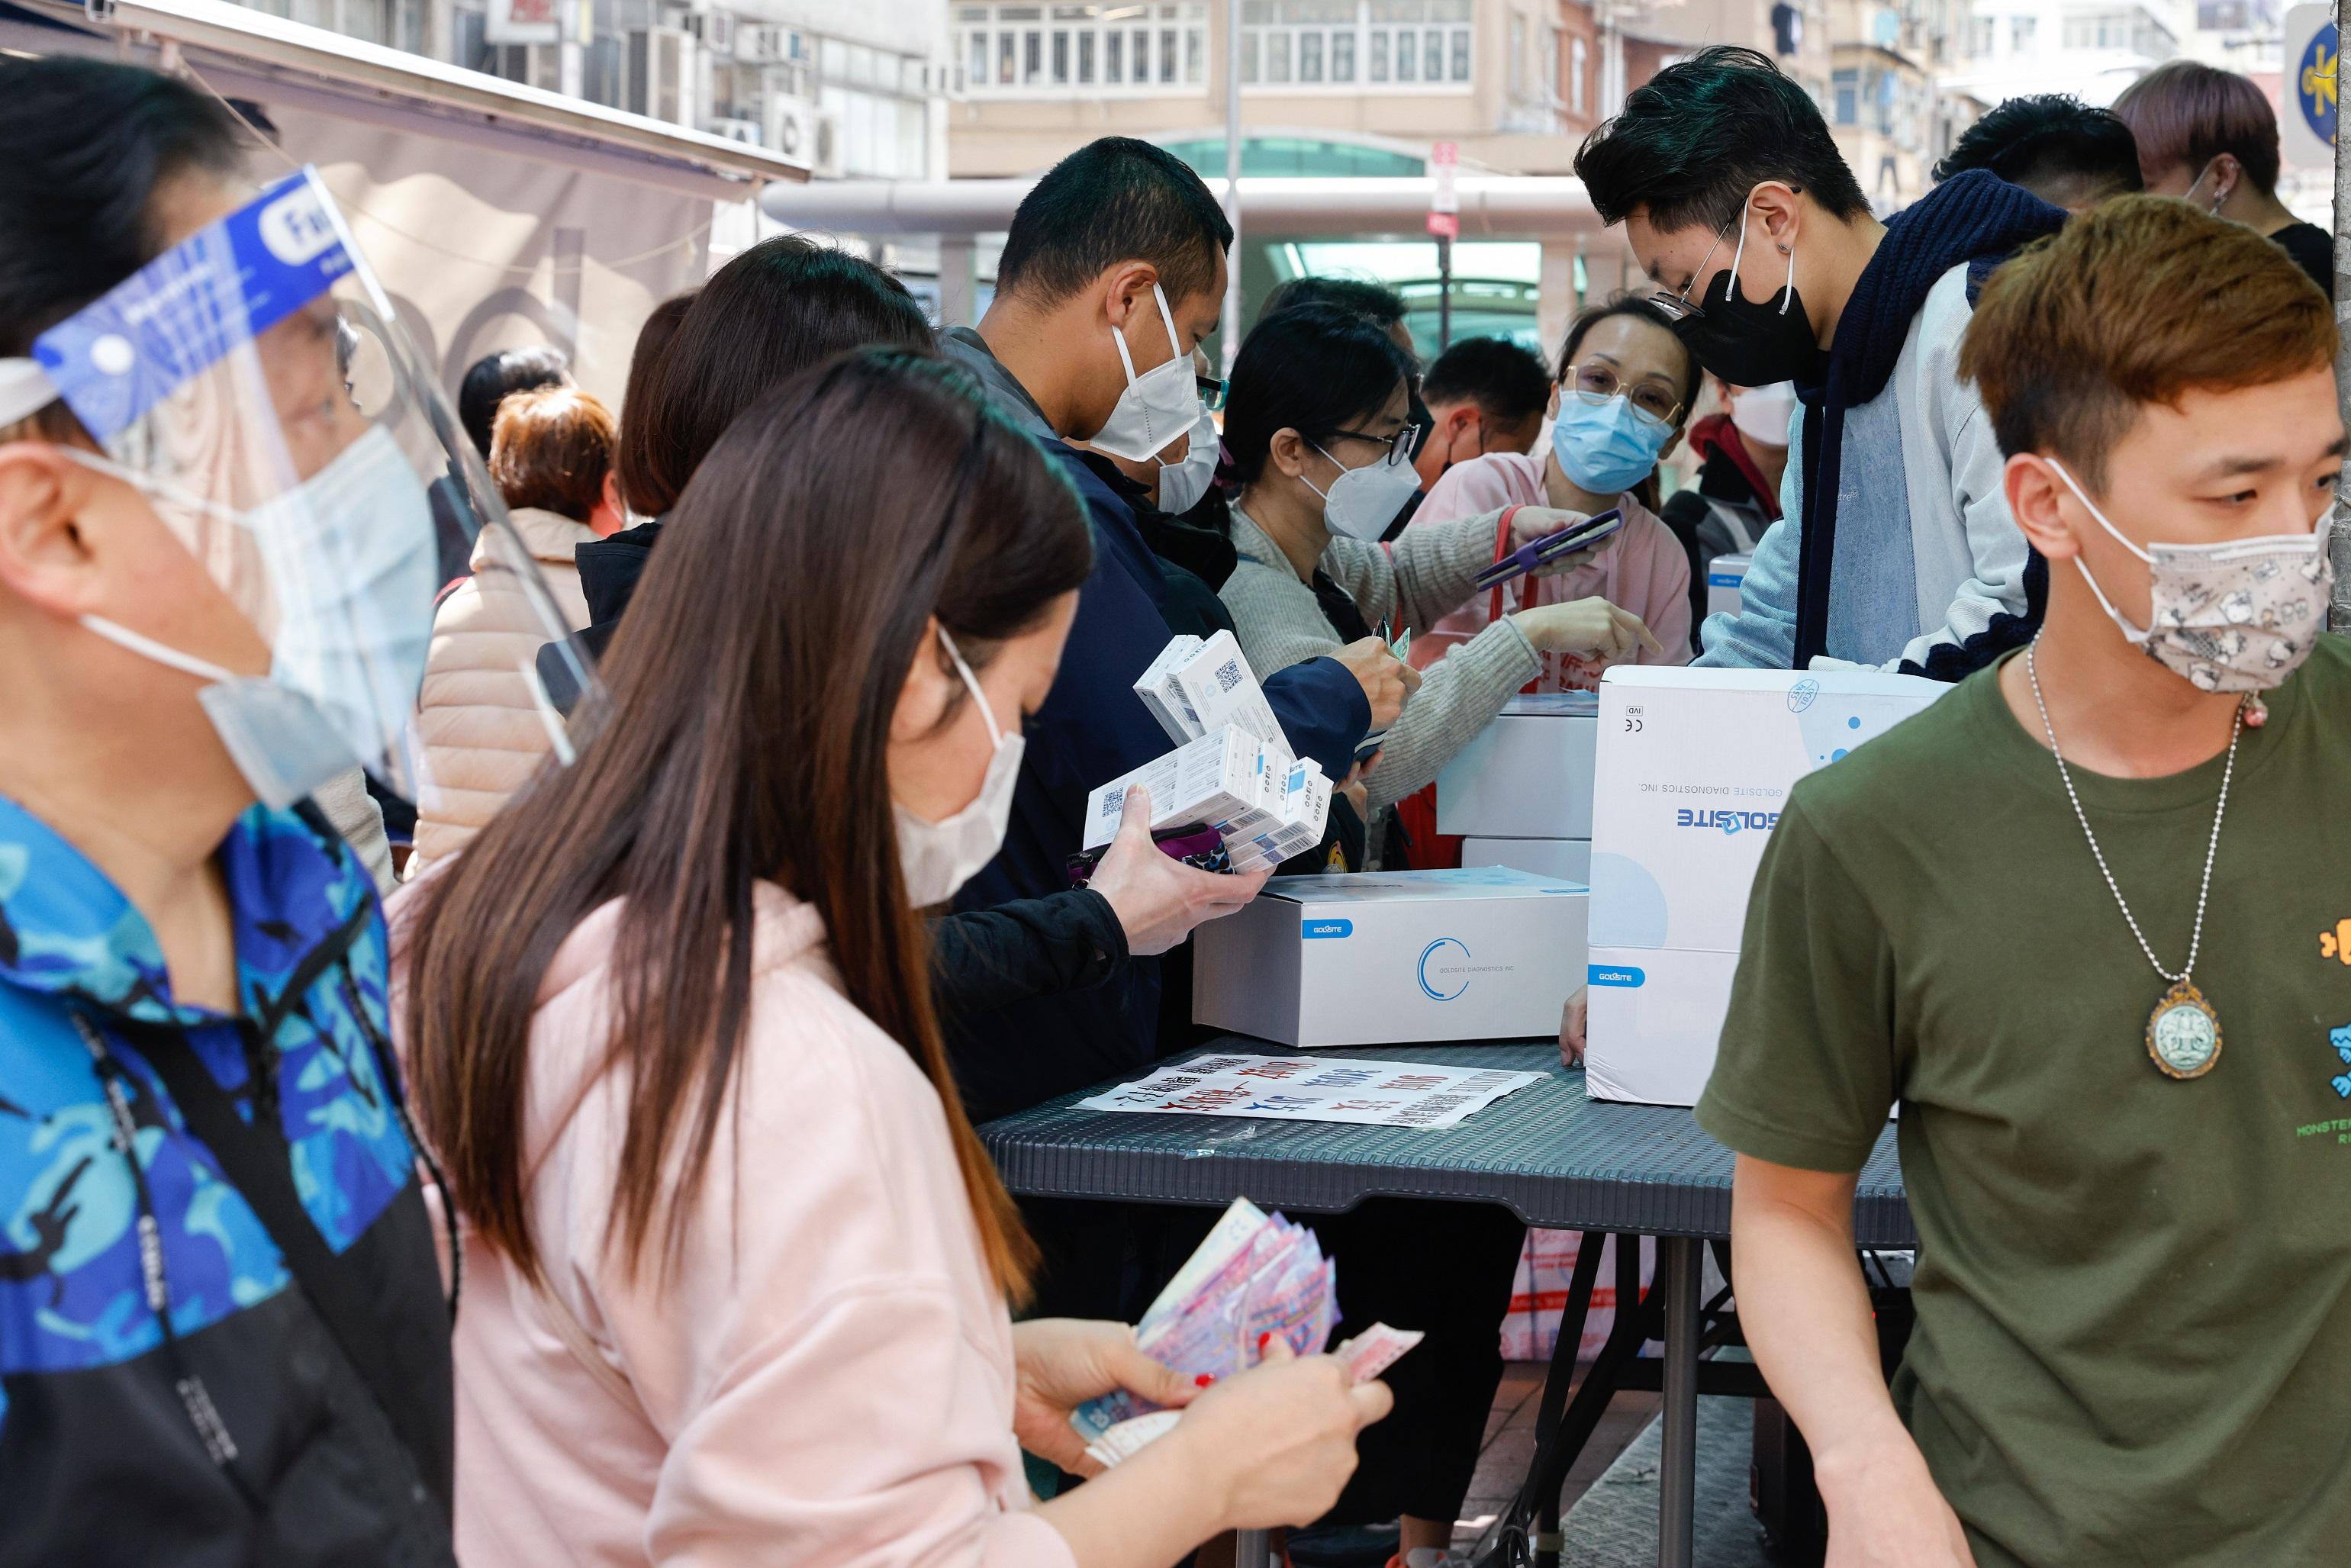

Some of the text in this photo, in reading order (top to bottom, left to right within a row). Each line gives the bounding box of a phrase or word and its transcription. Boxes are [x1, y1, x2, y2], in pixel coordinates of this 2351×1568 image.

[1791, 684, 1806, 700] PASS
[1625, 719, 1643, 732] CE
[1638, 784, 1783, 797] GOLDSITE DIAGNOSTICS INC.
[1599, 972, 1632, 982] GOLDSITE
